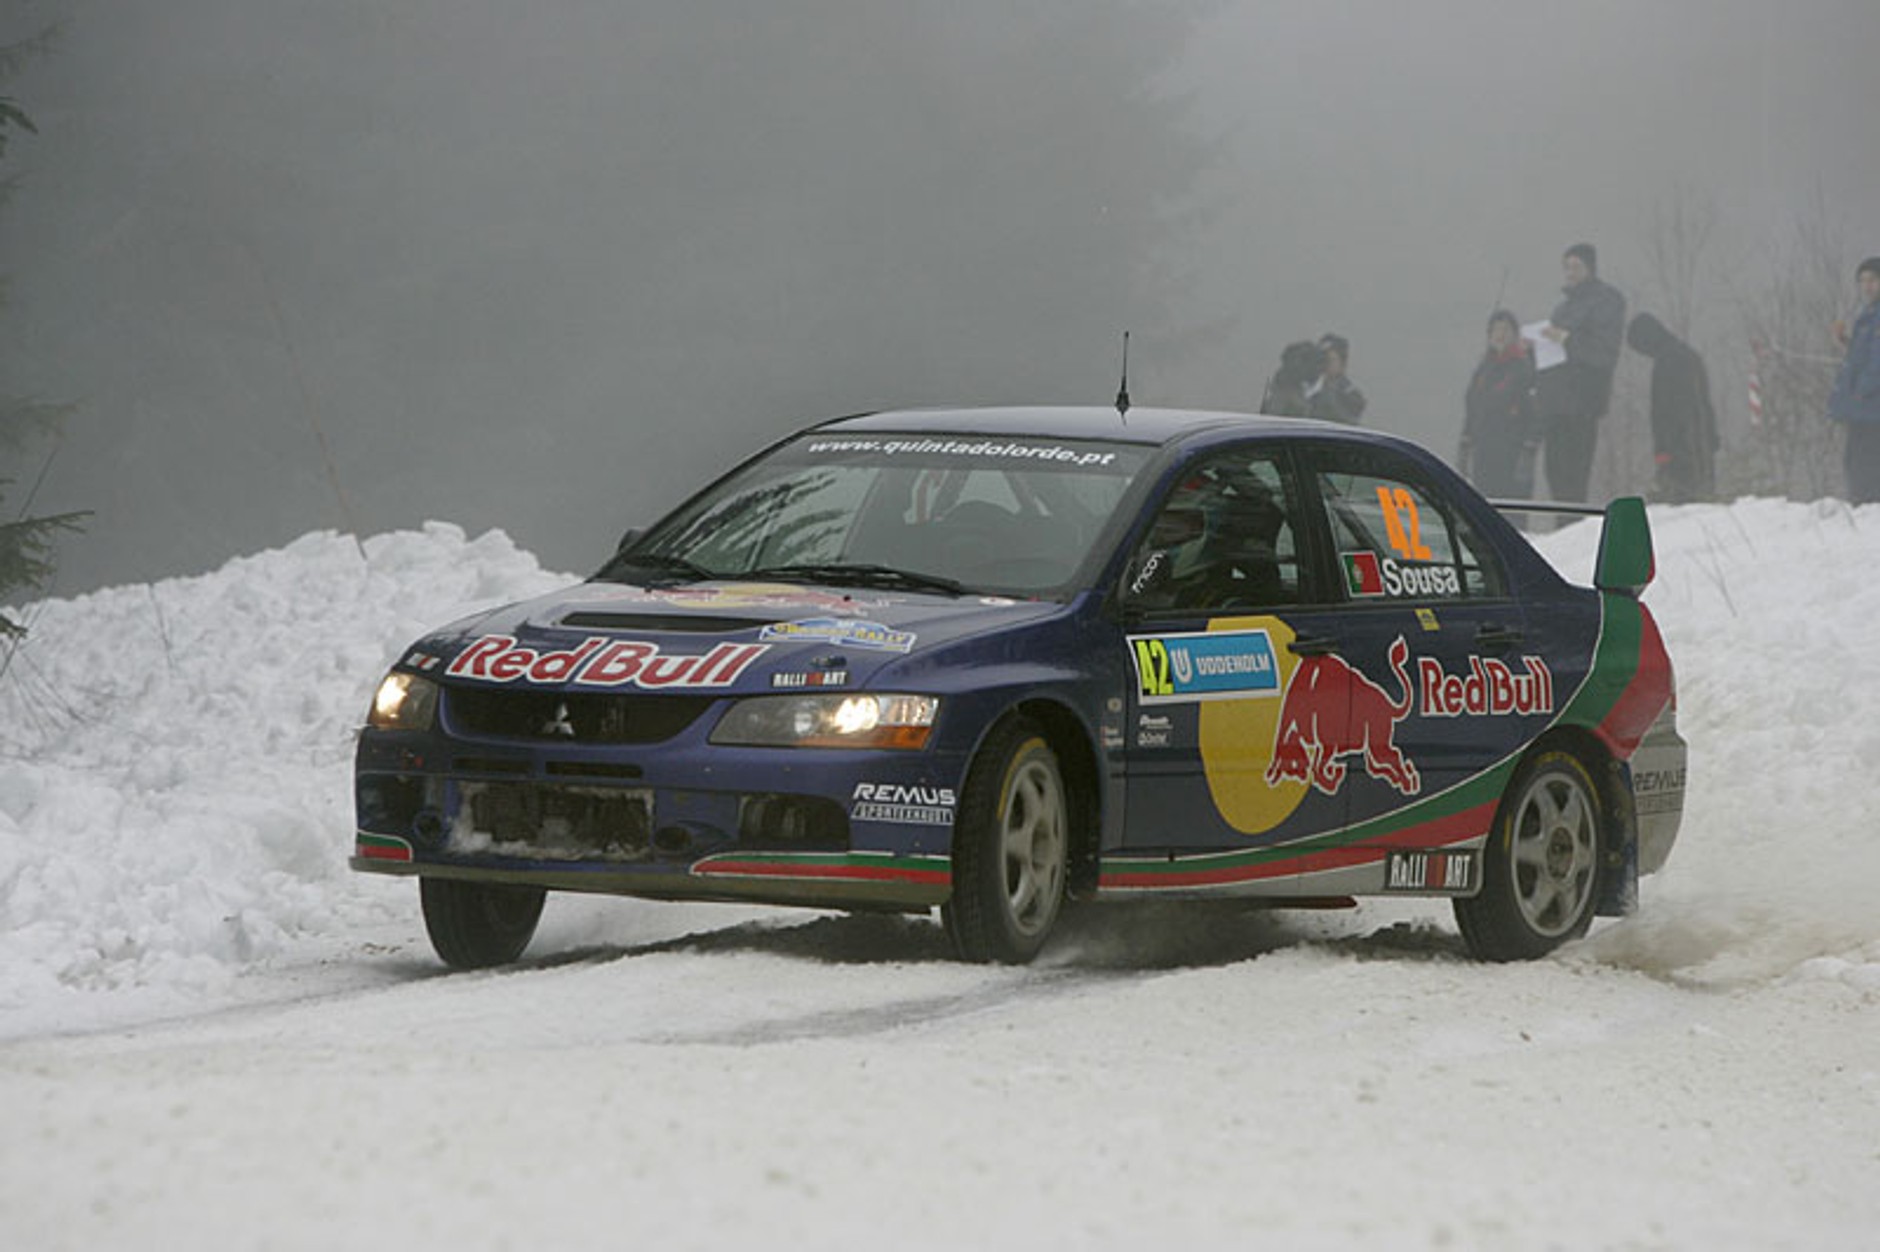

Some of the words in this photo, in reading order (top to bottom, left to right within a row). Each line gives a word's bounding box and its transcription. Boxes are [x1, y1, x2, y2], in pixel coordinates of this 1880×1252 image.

[808, 438, 1116, 466] www.quintadolorde.pt
[1375, 485, 1433, 561] 42
[1381, 557, 1461, 597] Sousa
[446, 634, 605, 683] Red
[574, 640, 771, 688] Bull
[1135, 638, 1175, 696] 42
[1195, 652, 1272, 677] UDDEHOLM
[1417, 655, 1489, 717] Red
[1482, 655, 1554, 717] Bull
[852, 782, 957, 805] REMUS
